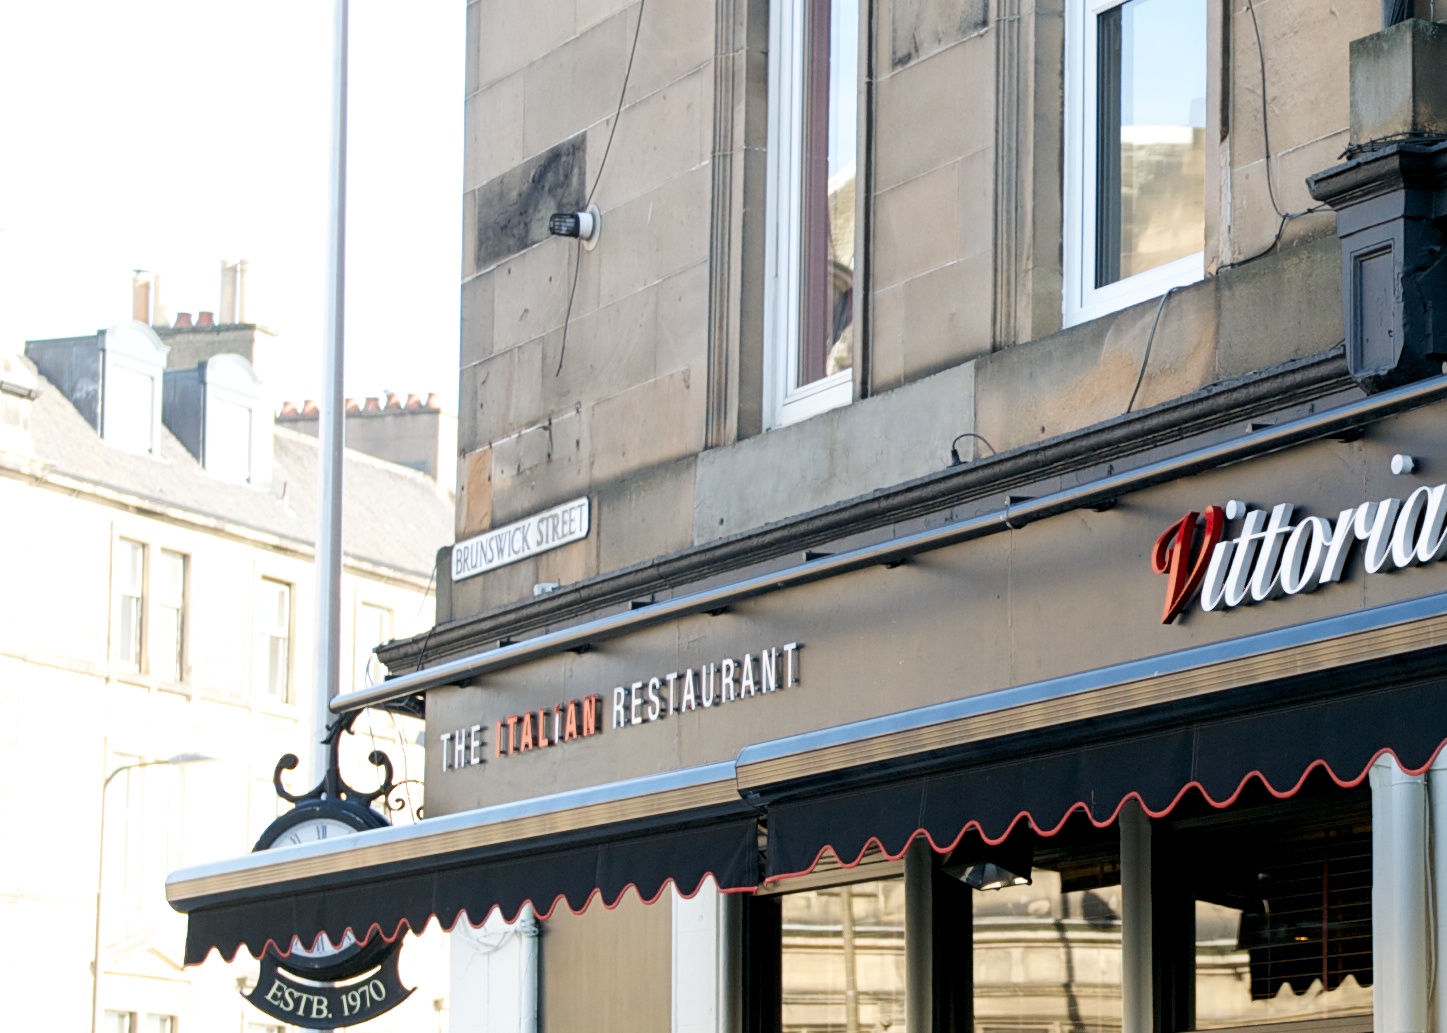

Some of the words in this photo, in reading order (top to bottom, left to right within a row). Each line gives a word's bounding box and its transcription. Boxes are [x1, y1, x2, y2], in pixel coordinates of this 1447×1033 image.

[455, 522, 532, 576] BRUNSWICK
[536, 502, 586, 548] STREET
[440, 724, 484, 772] THE
[612, 642, 798, 730] RESTAURANT
[264, 978, 333, 1019] ESTB.
[340, 978, 387, 1017] 1970
